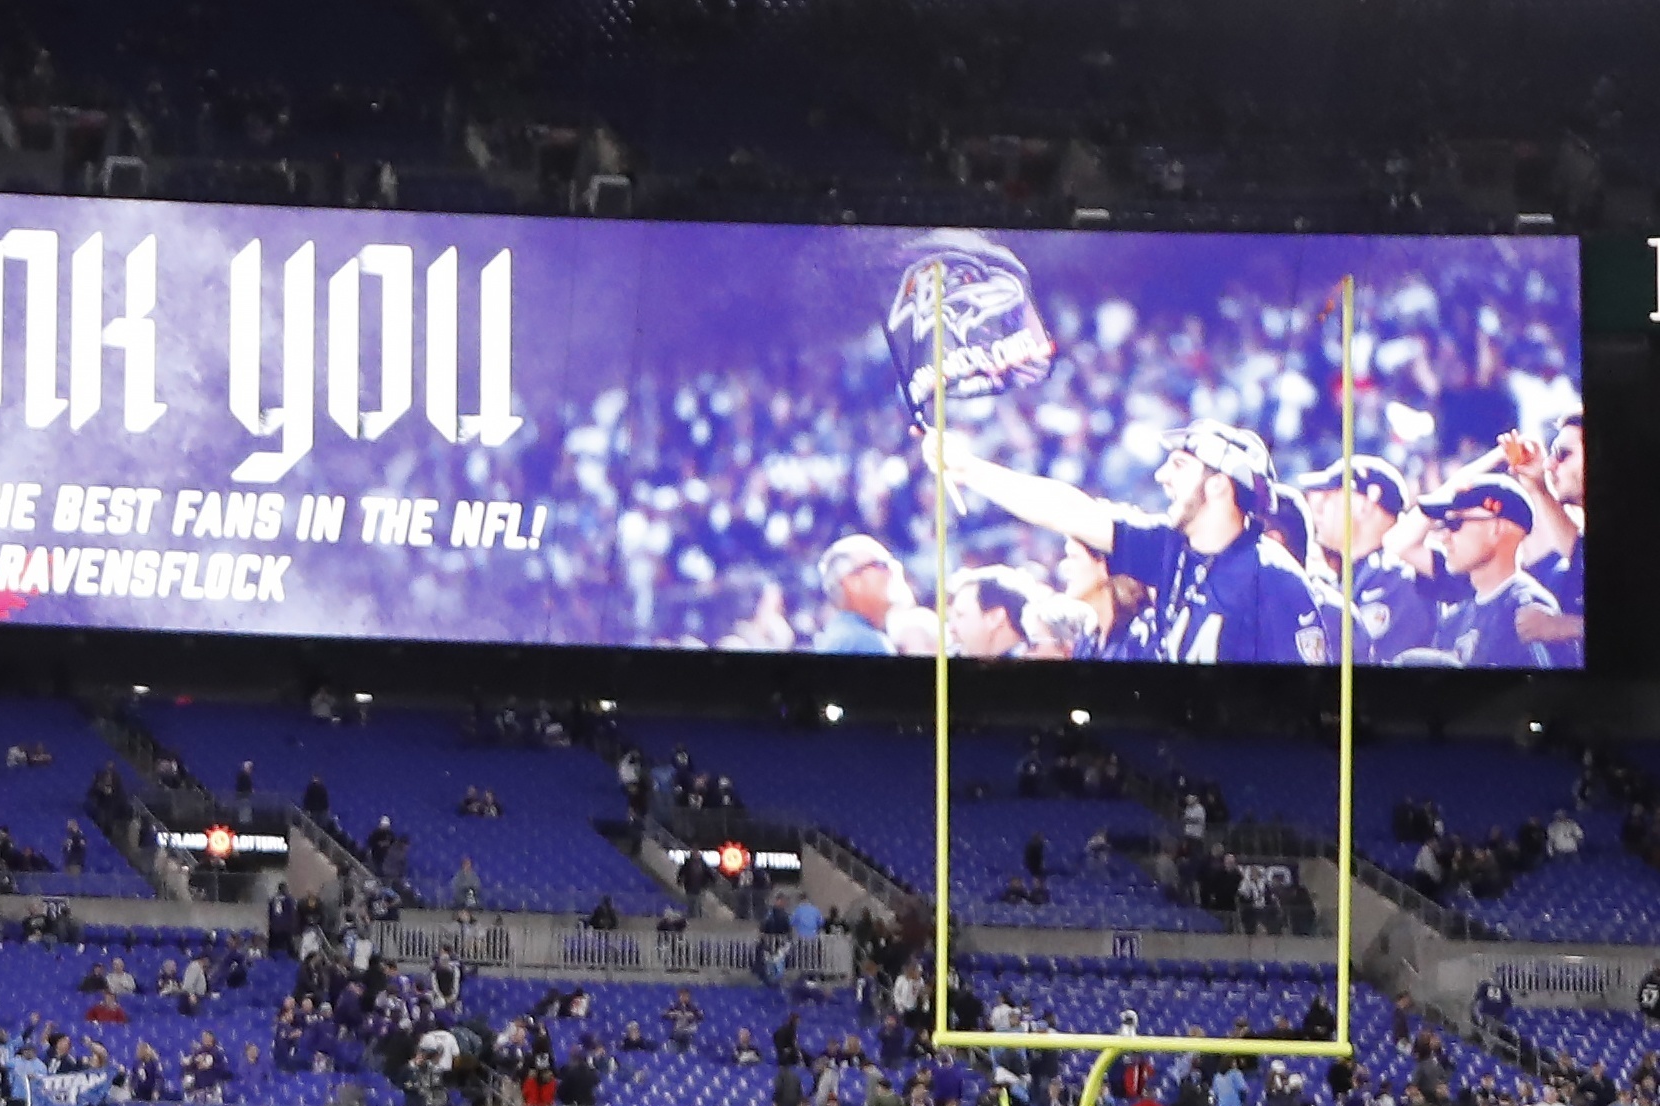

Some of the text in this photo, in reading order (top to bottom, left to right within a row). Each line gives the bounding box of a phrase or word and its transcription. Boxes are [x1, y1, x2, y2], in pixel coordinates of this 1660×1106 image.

[53, 485, 157, 538] BEST
[173, 490, 285, 543] FANS
[296, 495, 343, 545] IN
[359, 497, 439, 549] THE
[451, 499, 548, 552] NFL!
